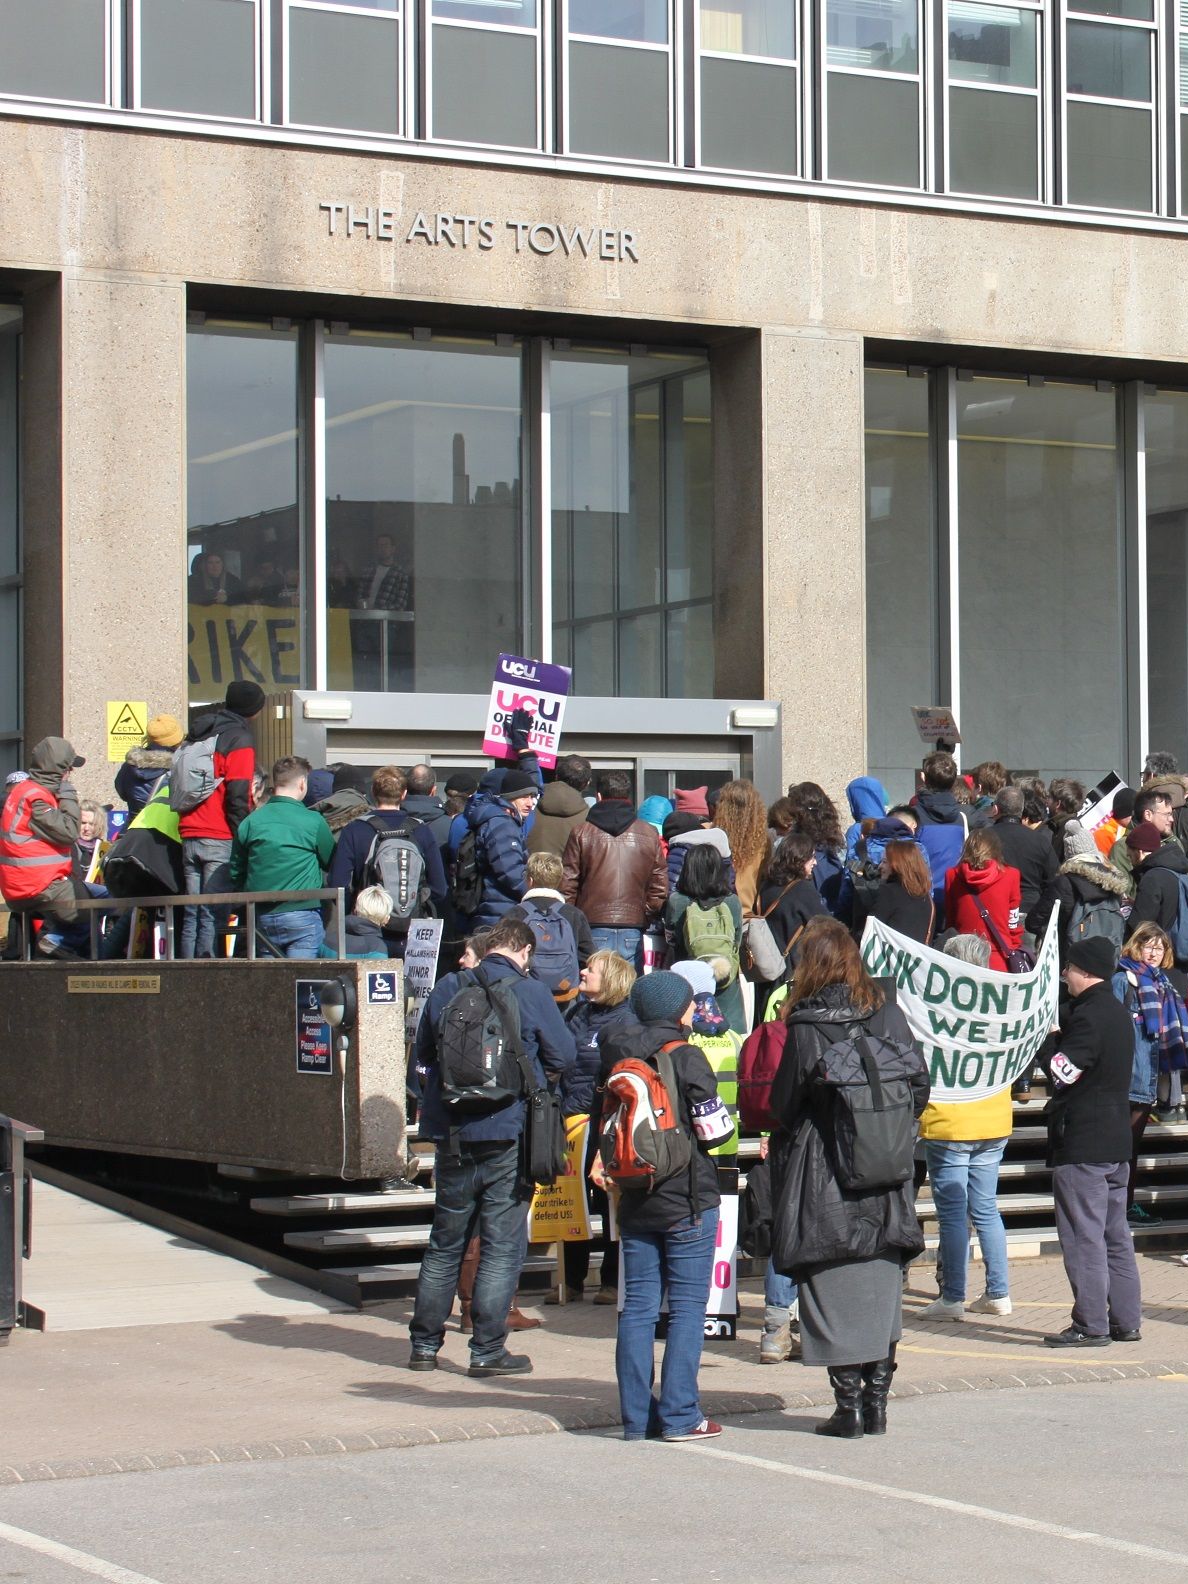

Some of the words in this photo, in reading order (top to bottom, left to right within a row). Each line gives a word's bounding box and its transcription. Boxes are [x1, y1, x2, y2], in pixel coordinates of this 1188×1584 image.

[319, 202, 394, 240] THE
[406, 212, 496, 251] ARTS
[506, 220, 639, 264] TOWER
[415, 928, 433, 941] KEEP
[923, 963, 1040, 1014] DON'T
[371, 992, 393, 1001] Ramp
[305, 1025, 322, 1036] Access
[928, 1010, 990, 1043] WE
[301, 1040, 315, 1050] Please
[316, 1041, 327, 1053] Keep
[301, 1053, 314, 1065] Ramp
[315, 1053, 326, 1064] Clear
[535, 1185, 562, 1197] Support
[535, 1200, 548, 1208] our
[535, 1211, 559, 1220] defend
